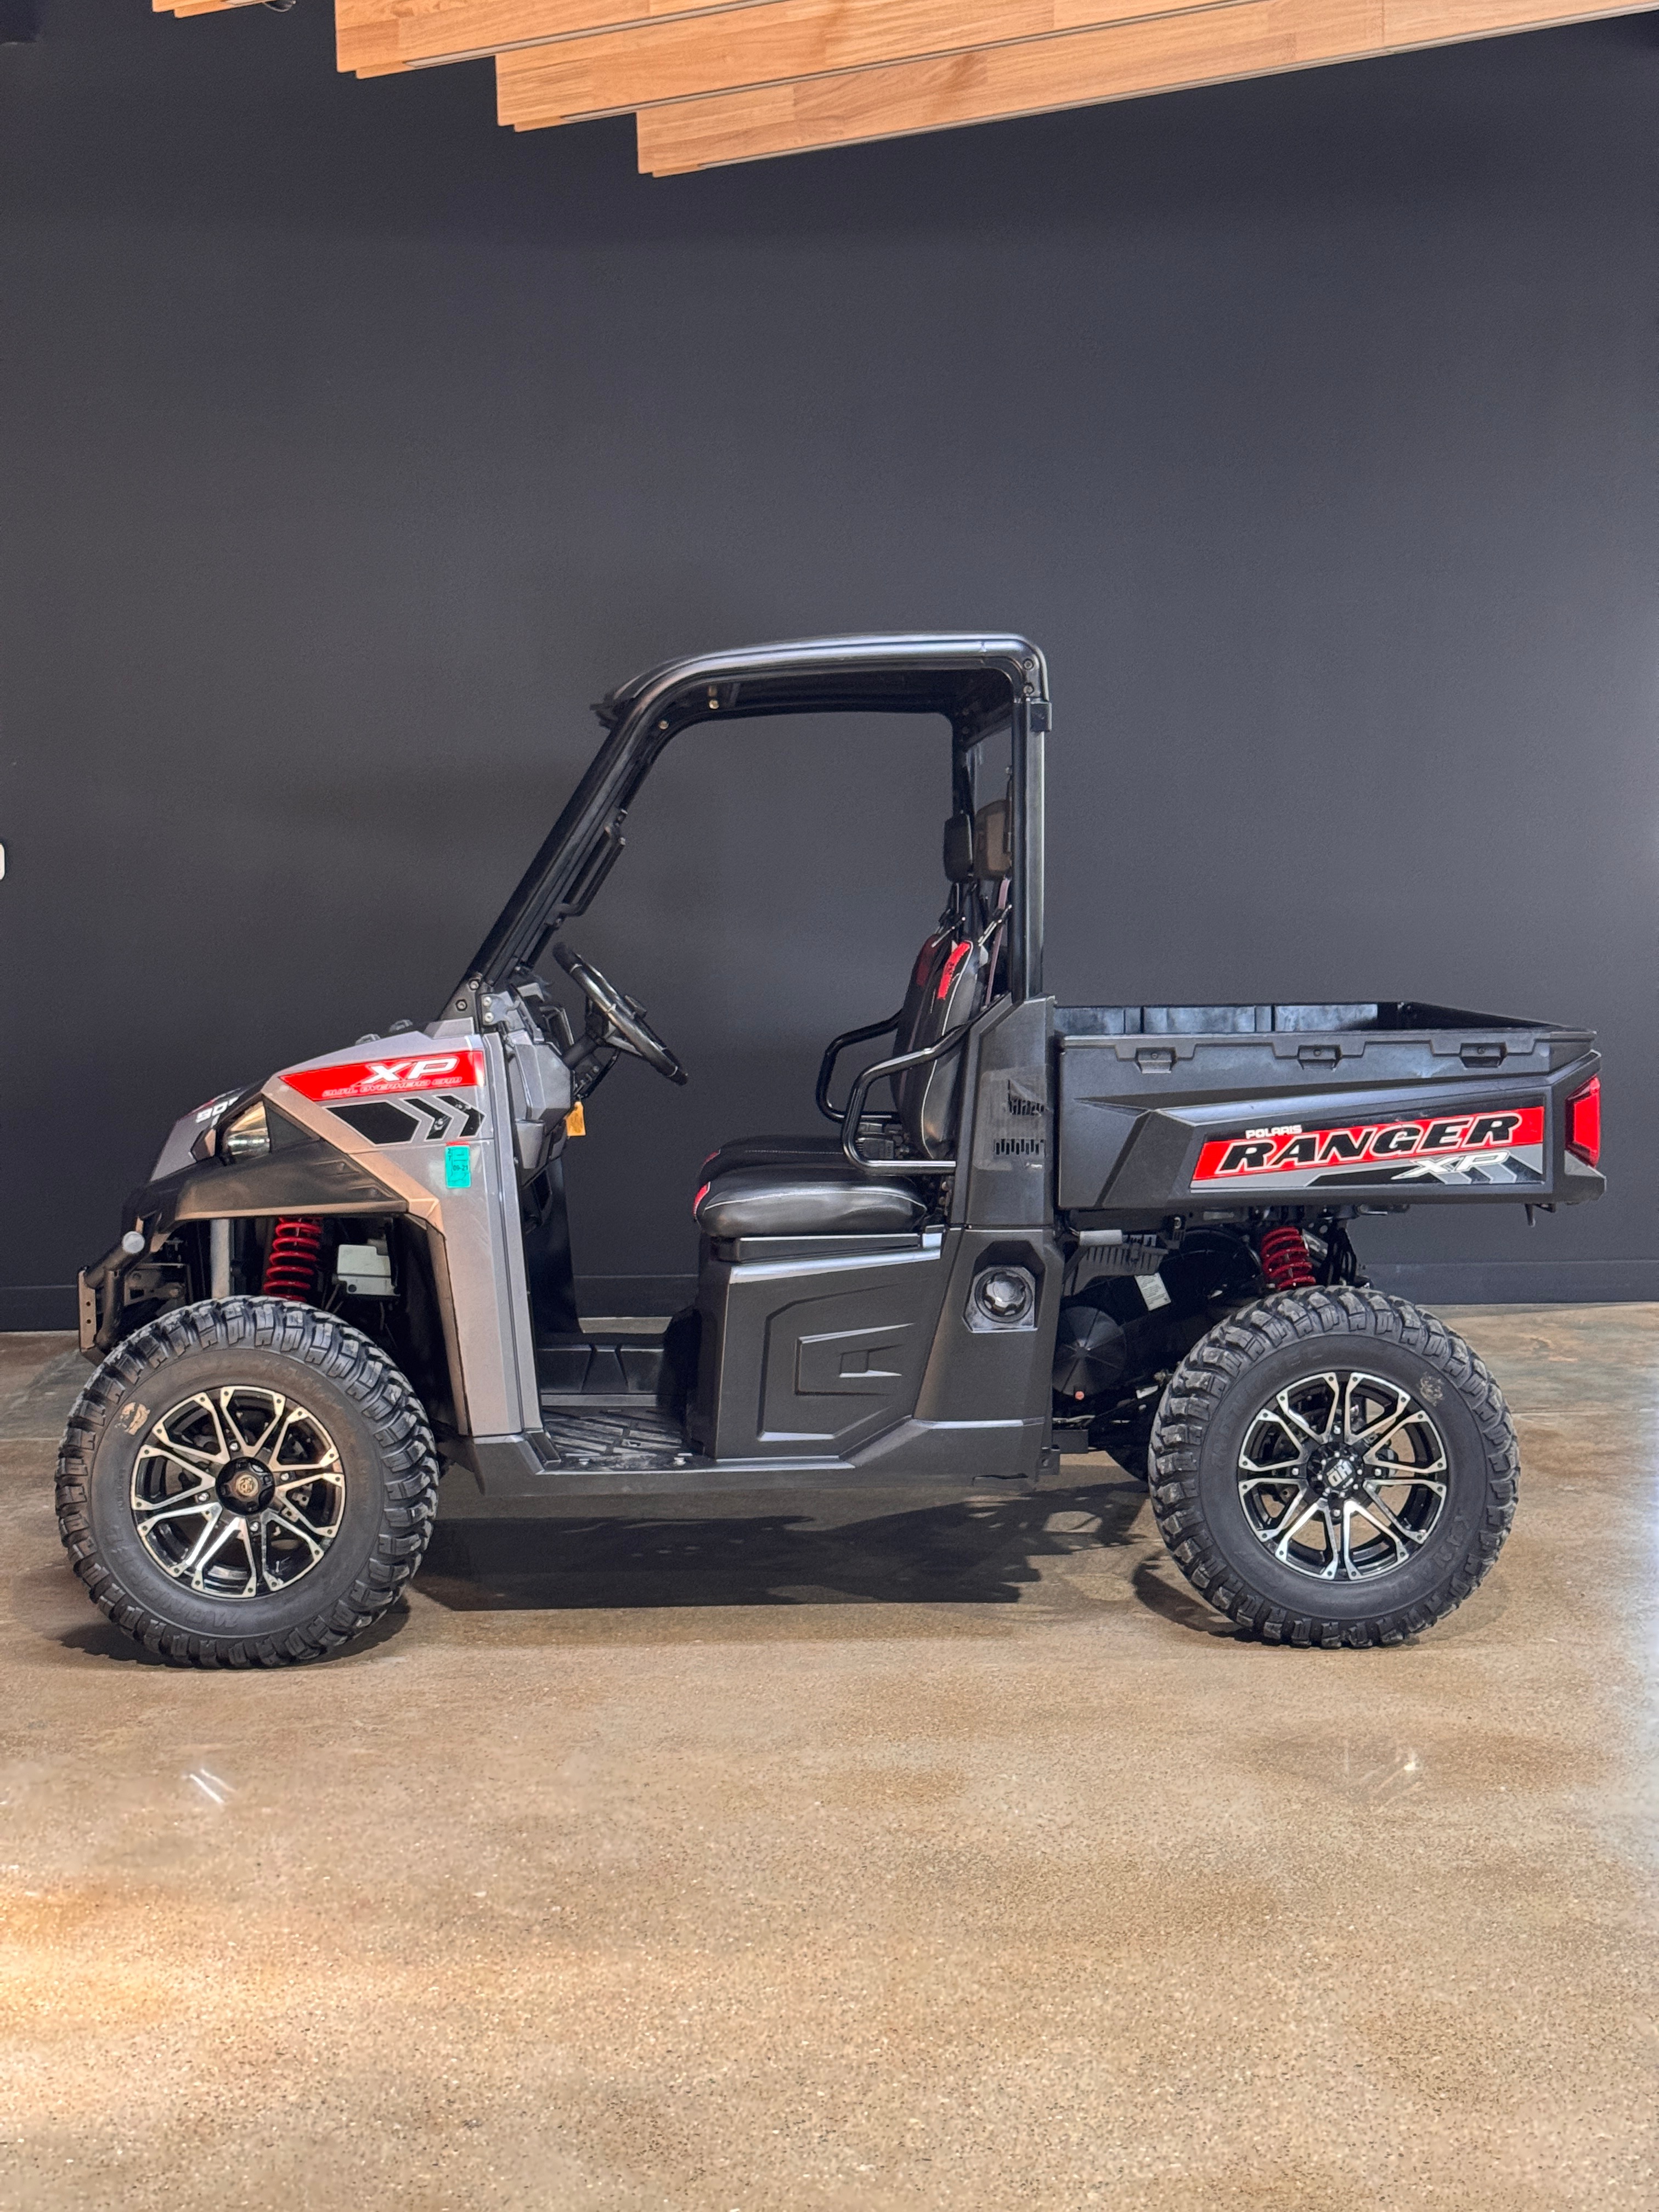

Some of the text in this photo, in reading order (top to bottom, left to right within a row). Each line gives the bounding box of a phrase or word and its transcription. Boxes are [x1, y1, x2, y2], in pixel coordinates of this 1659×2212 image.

[356, 1056, 460, 1086] XP
[1215, 1113, 1522, 1175] RANGER
[1245, 1125, 1302, 1139] POLARIS
[1392, 1150, 1510, 1180] XP
